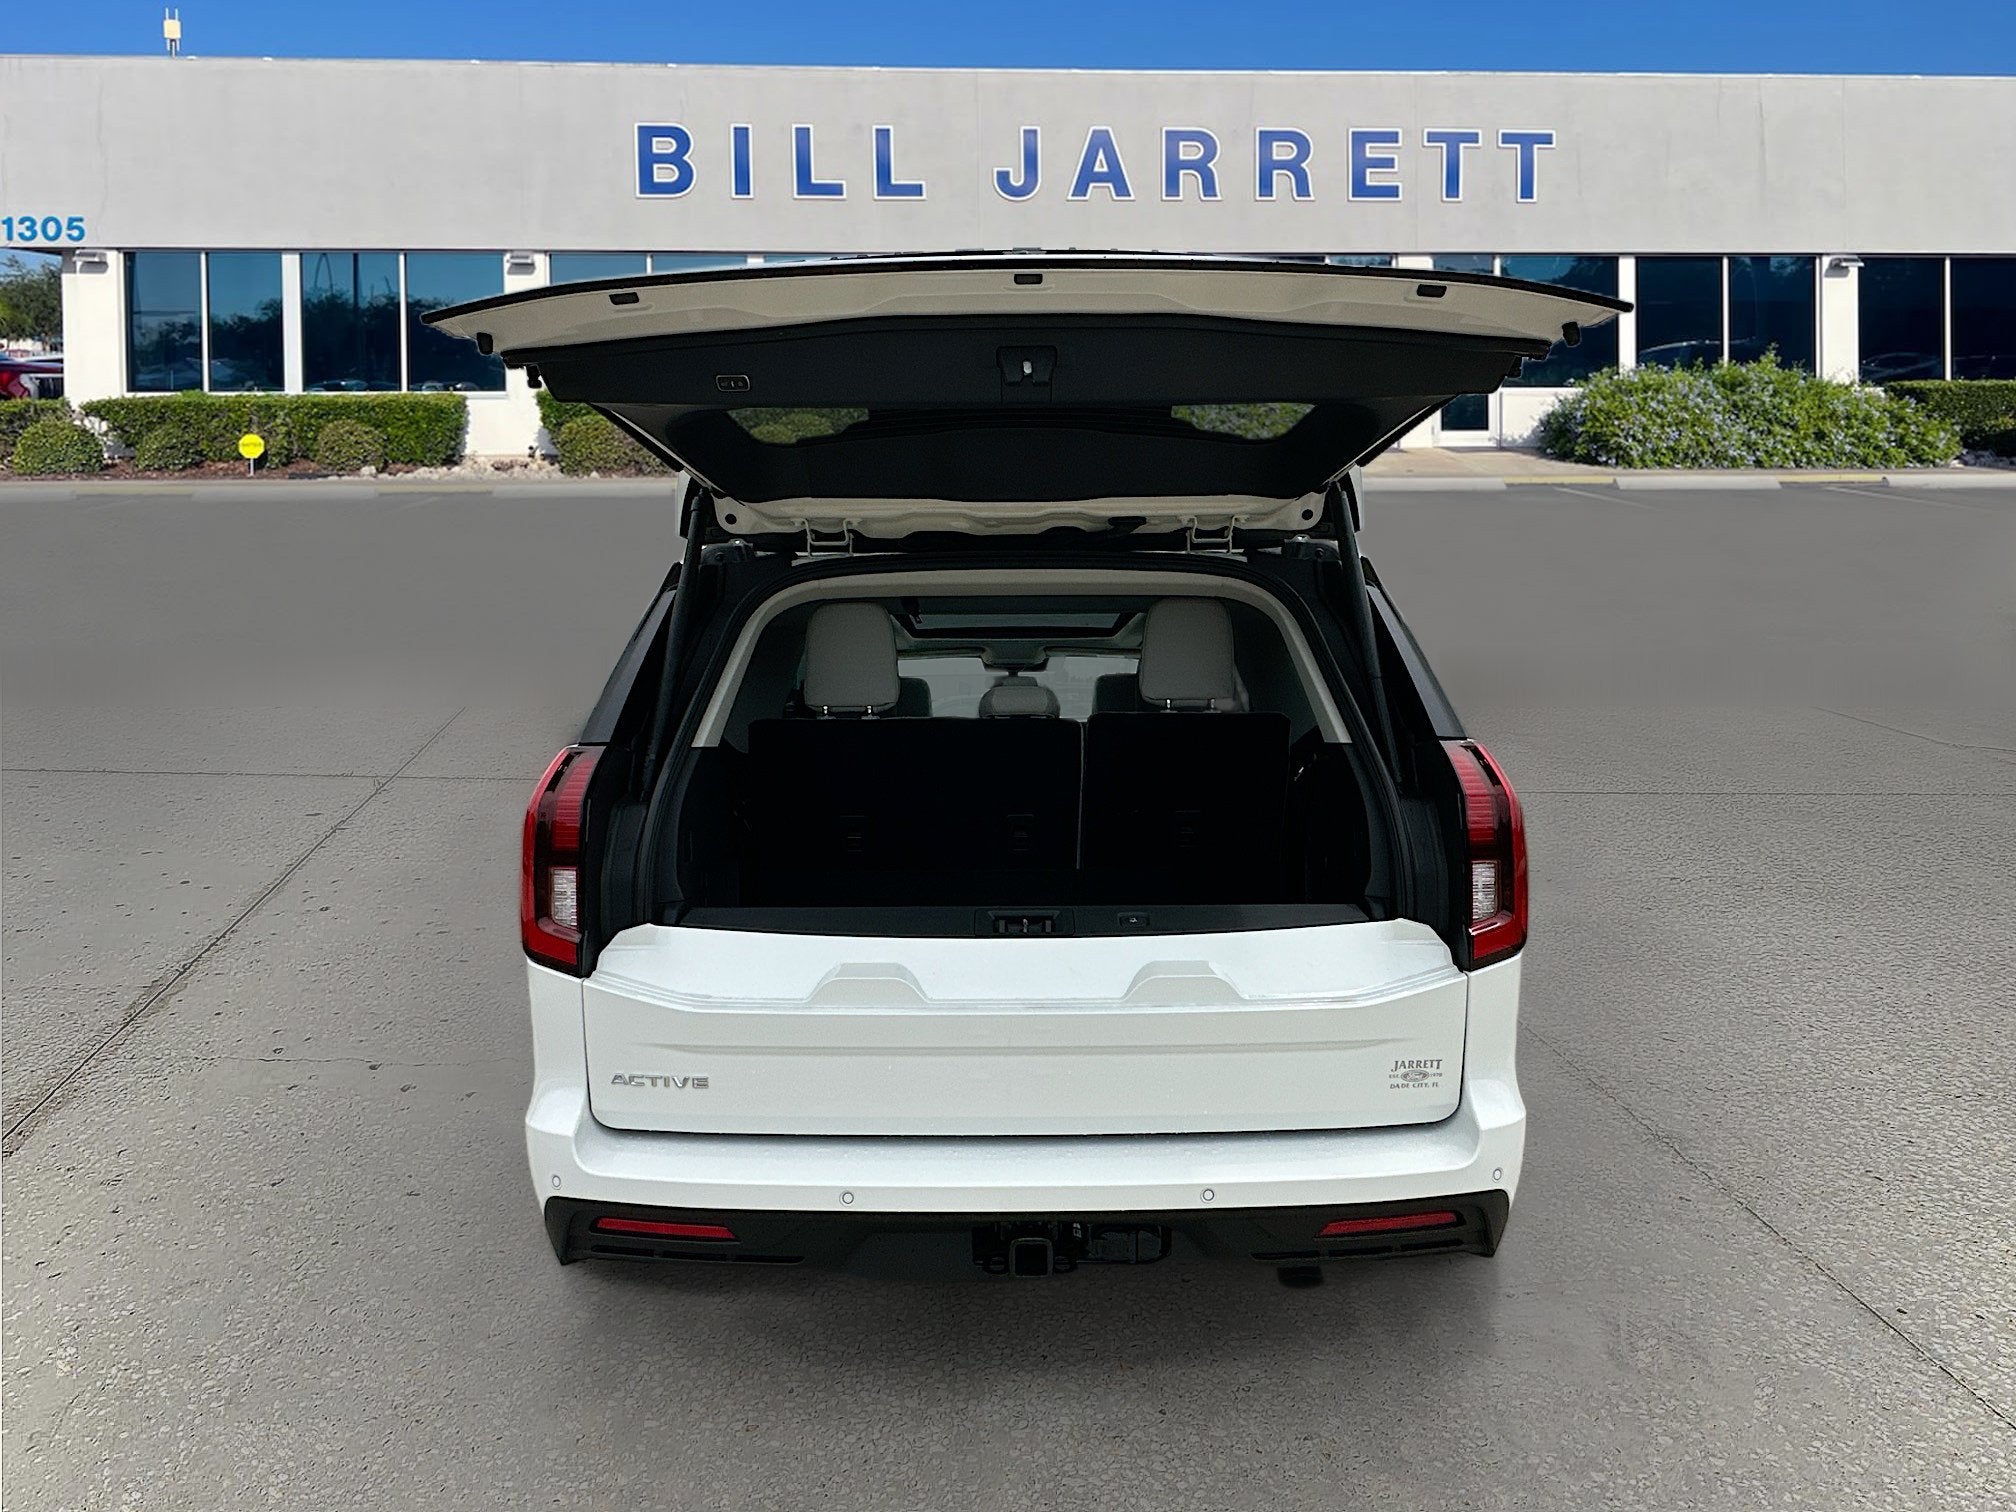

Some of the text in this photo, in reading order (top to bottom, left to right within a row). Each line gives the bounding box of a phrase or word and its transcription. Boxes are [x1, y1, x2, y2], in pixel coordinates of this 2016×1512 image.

[634, 122, 1556, 203] BILL JARRETT
[1, 216, 86, 242] 1305
[1390, 1059, 1443, 1072] JARRETT
[610, 1072, 710, 1090] ACTIVE
[1389, 1082, 1410, 1090] DADE
